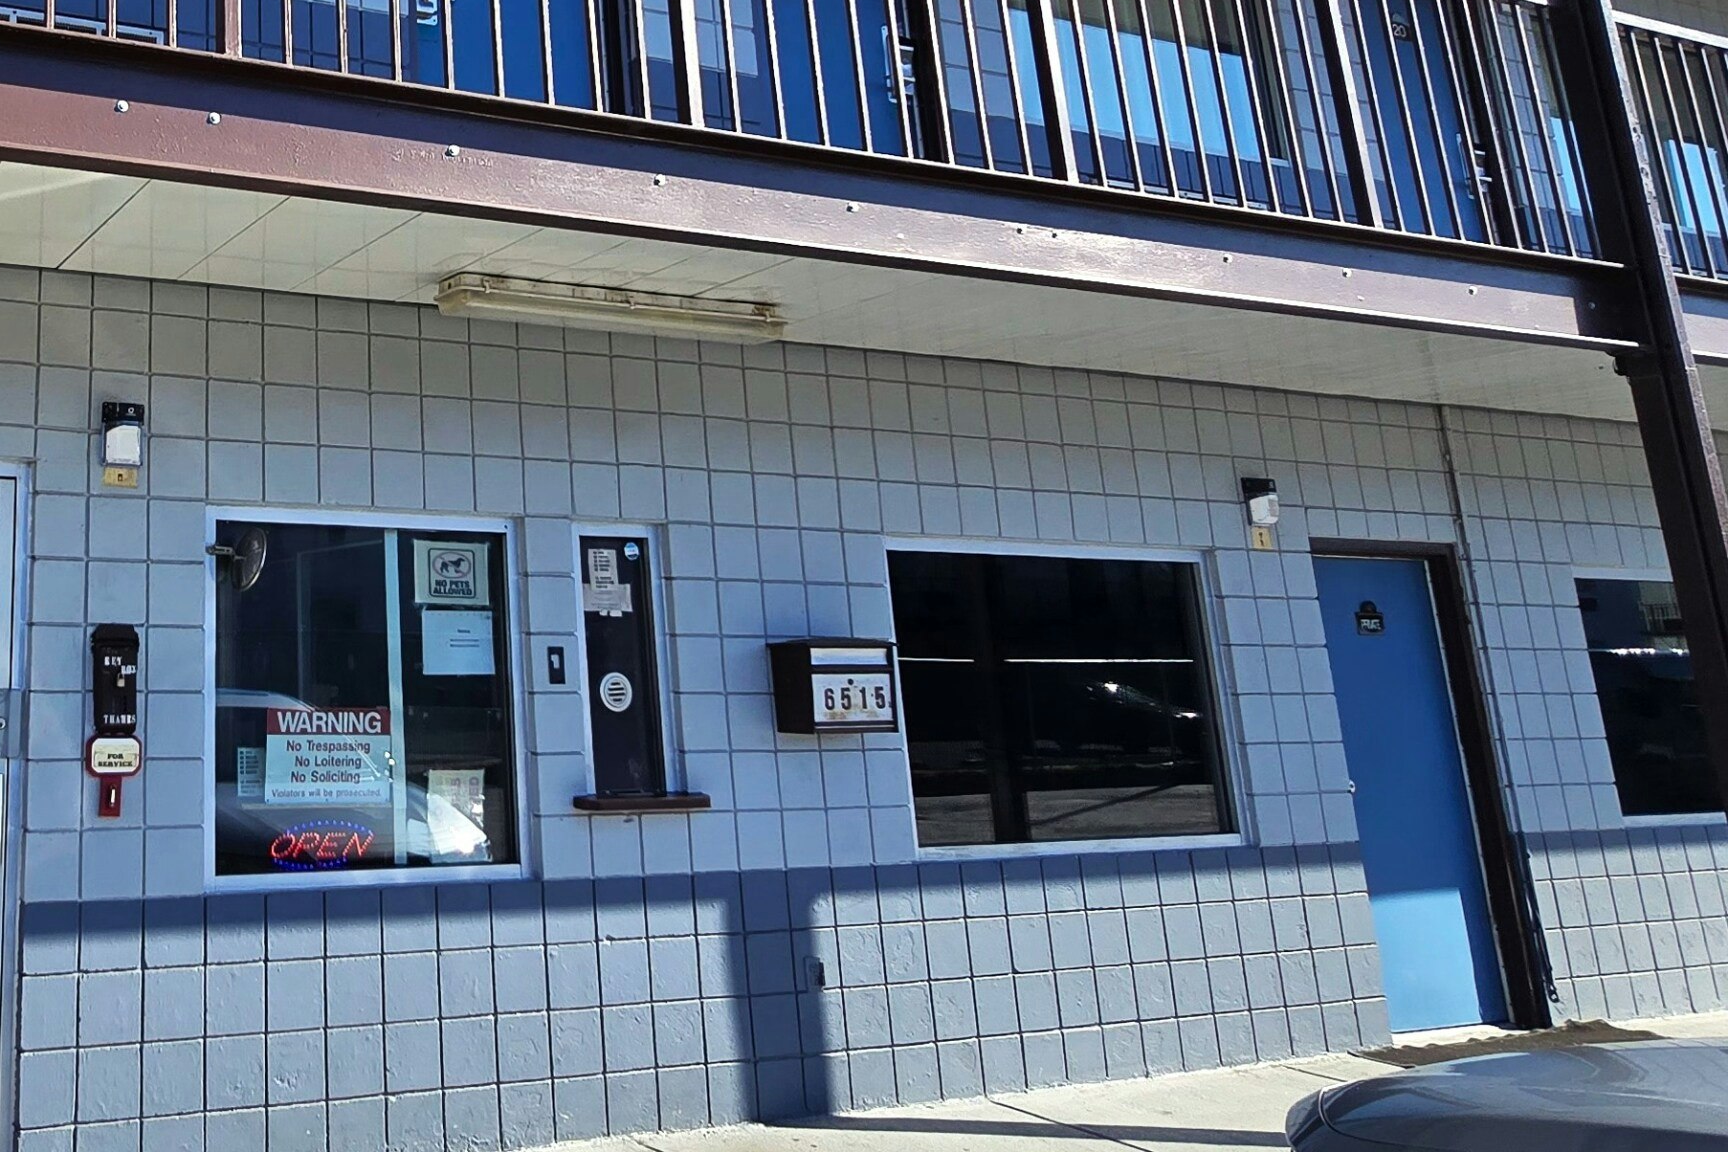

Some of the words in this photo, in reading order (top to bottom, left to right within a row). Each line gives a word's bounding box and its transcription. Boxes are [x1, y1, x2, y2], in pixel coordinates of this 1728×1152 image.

[1392, 23, 1407, 38] 20
[435, 579, 447, 588] NO
[450, 580, 470, 588] PETS
[433, 587, 472, 596] ALLOWED
[824, 686, 886, 711] 6515
[277, 711, 382, 734] WARNING
[286, 739, 302, 752] No
[306, 739, 371, 754] Trespassing
[98, 760, 133, 768] SERVICE
[295, 755, 309, 767] No
[314, 755, 362, 768] Loitering
[291, 771, 306, 783] No
[311, 770, 360, 784] Soliciting
[272, 789, 305, 798] Violators
[308, 789, 321, 797] will
[323, 789, 333, 797] be
[271, 831, 374, 858] OPEN
